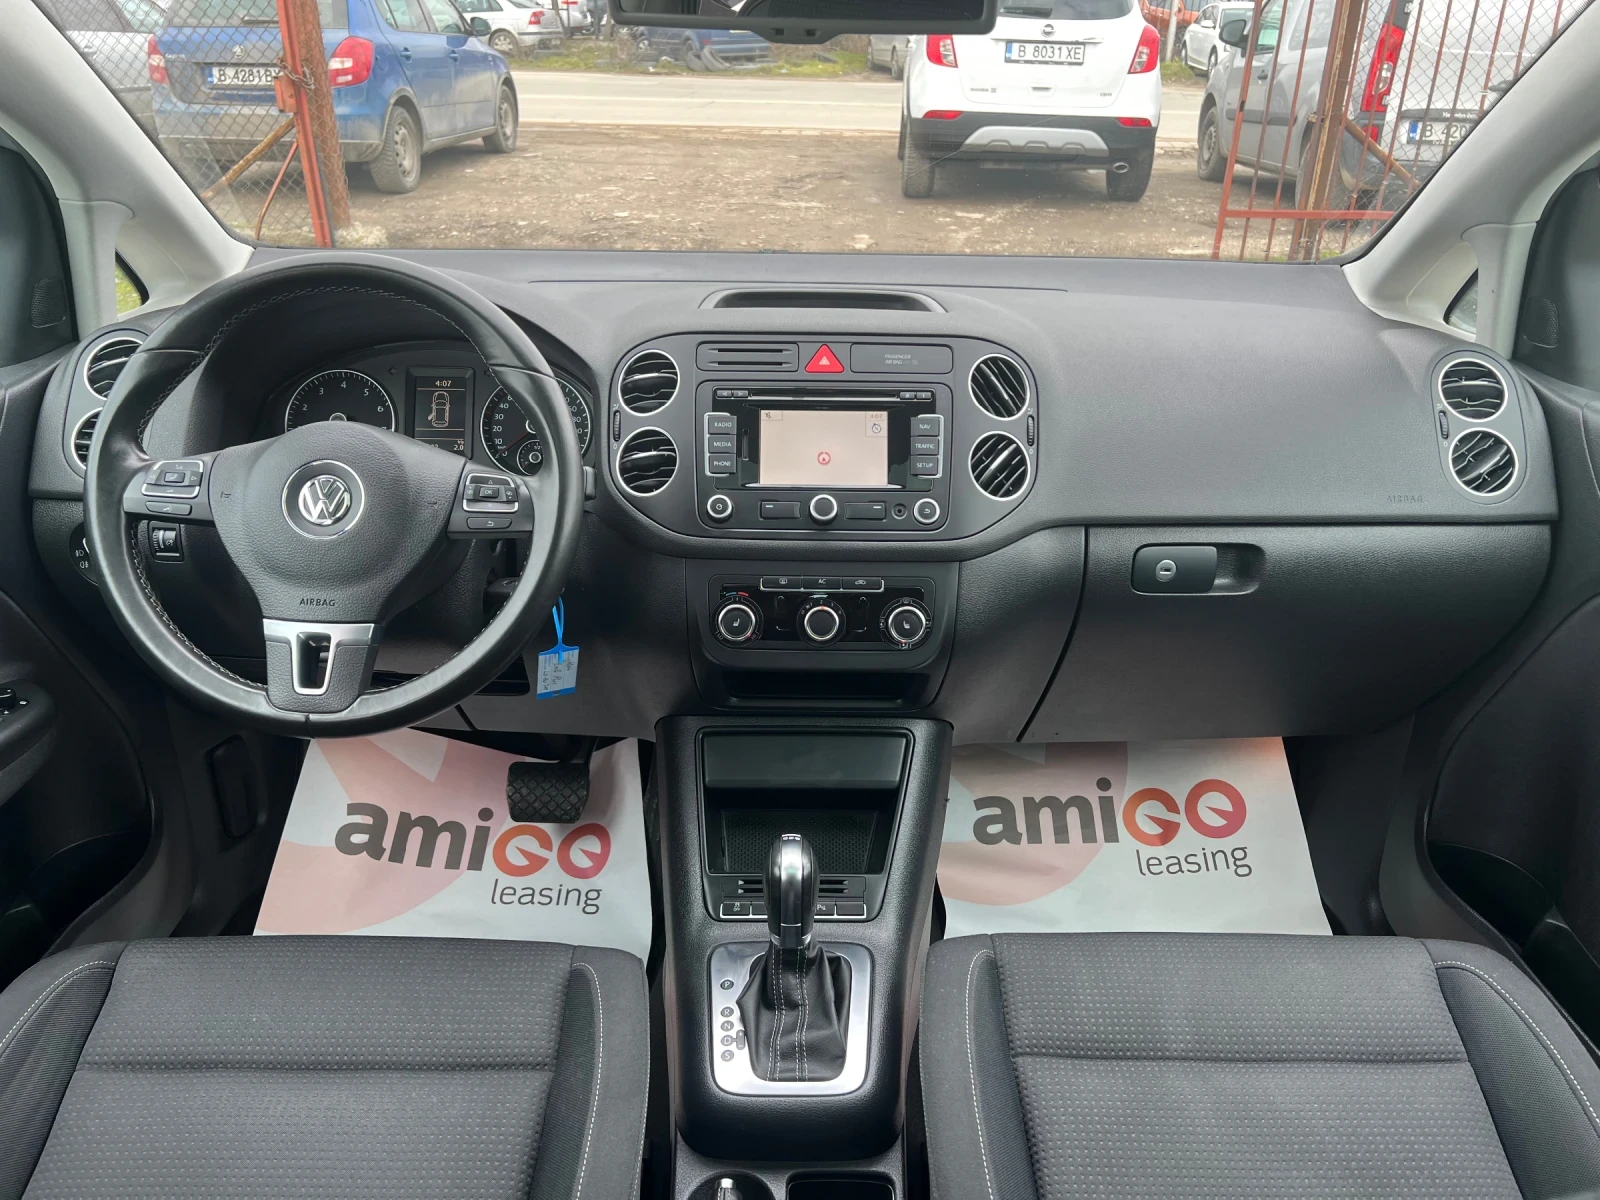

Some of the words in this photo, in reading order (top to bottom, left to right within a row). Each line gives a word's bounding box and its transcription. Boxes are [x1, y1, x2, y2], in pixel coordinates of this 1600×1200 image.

[1018, 45, 1026, 58] B
[1033, 45, 1062, 59] 8031
[1066, 46, 1082, 60] XE
[218, 69, 227, 83] B
[232, 68, 261, 83] 4281
[340, 381, 347, 389] 4
[363, 388, 369, 396] 5
[1387, 495, 1423, 503] AIRBAG
[298, 597, 336, 607] AIRBAG
[972, 776, 1247, 847] amiGO
[334, 801, 611, 879] amiGO
[1135, 846, 1253, 877] leasing
[490, 878, 603, 915] leasing
